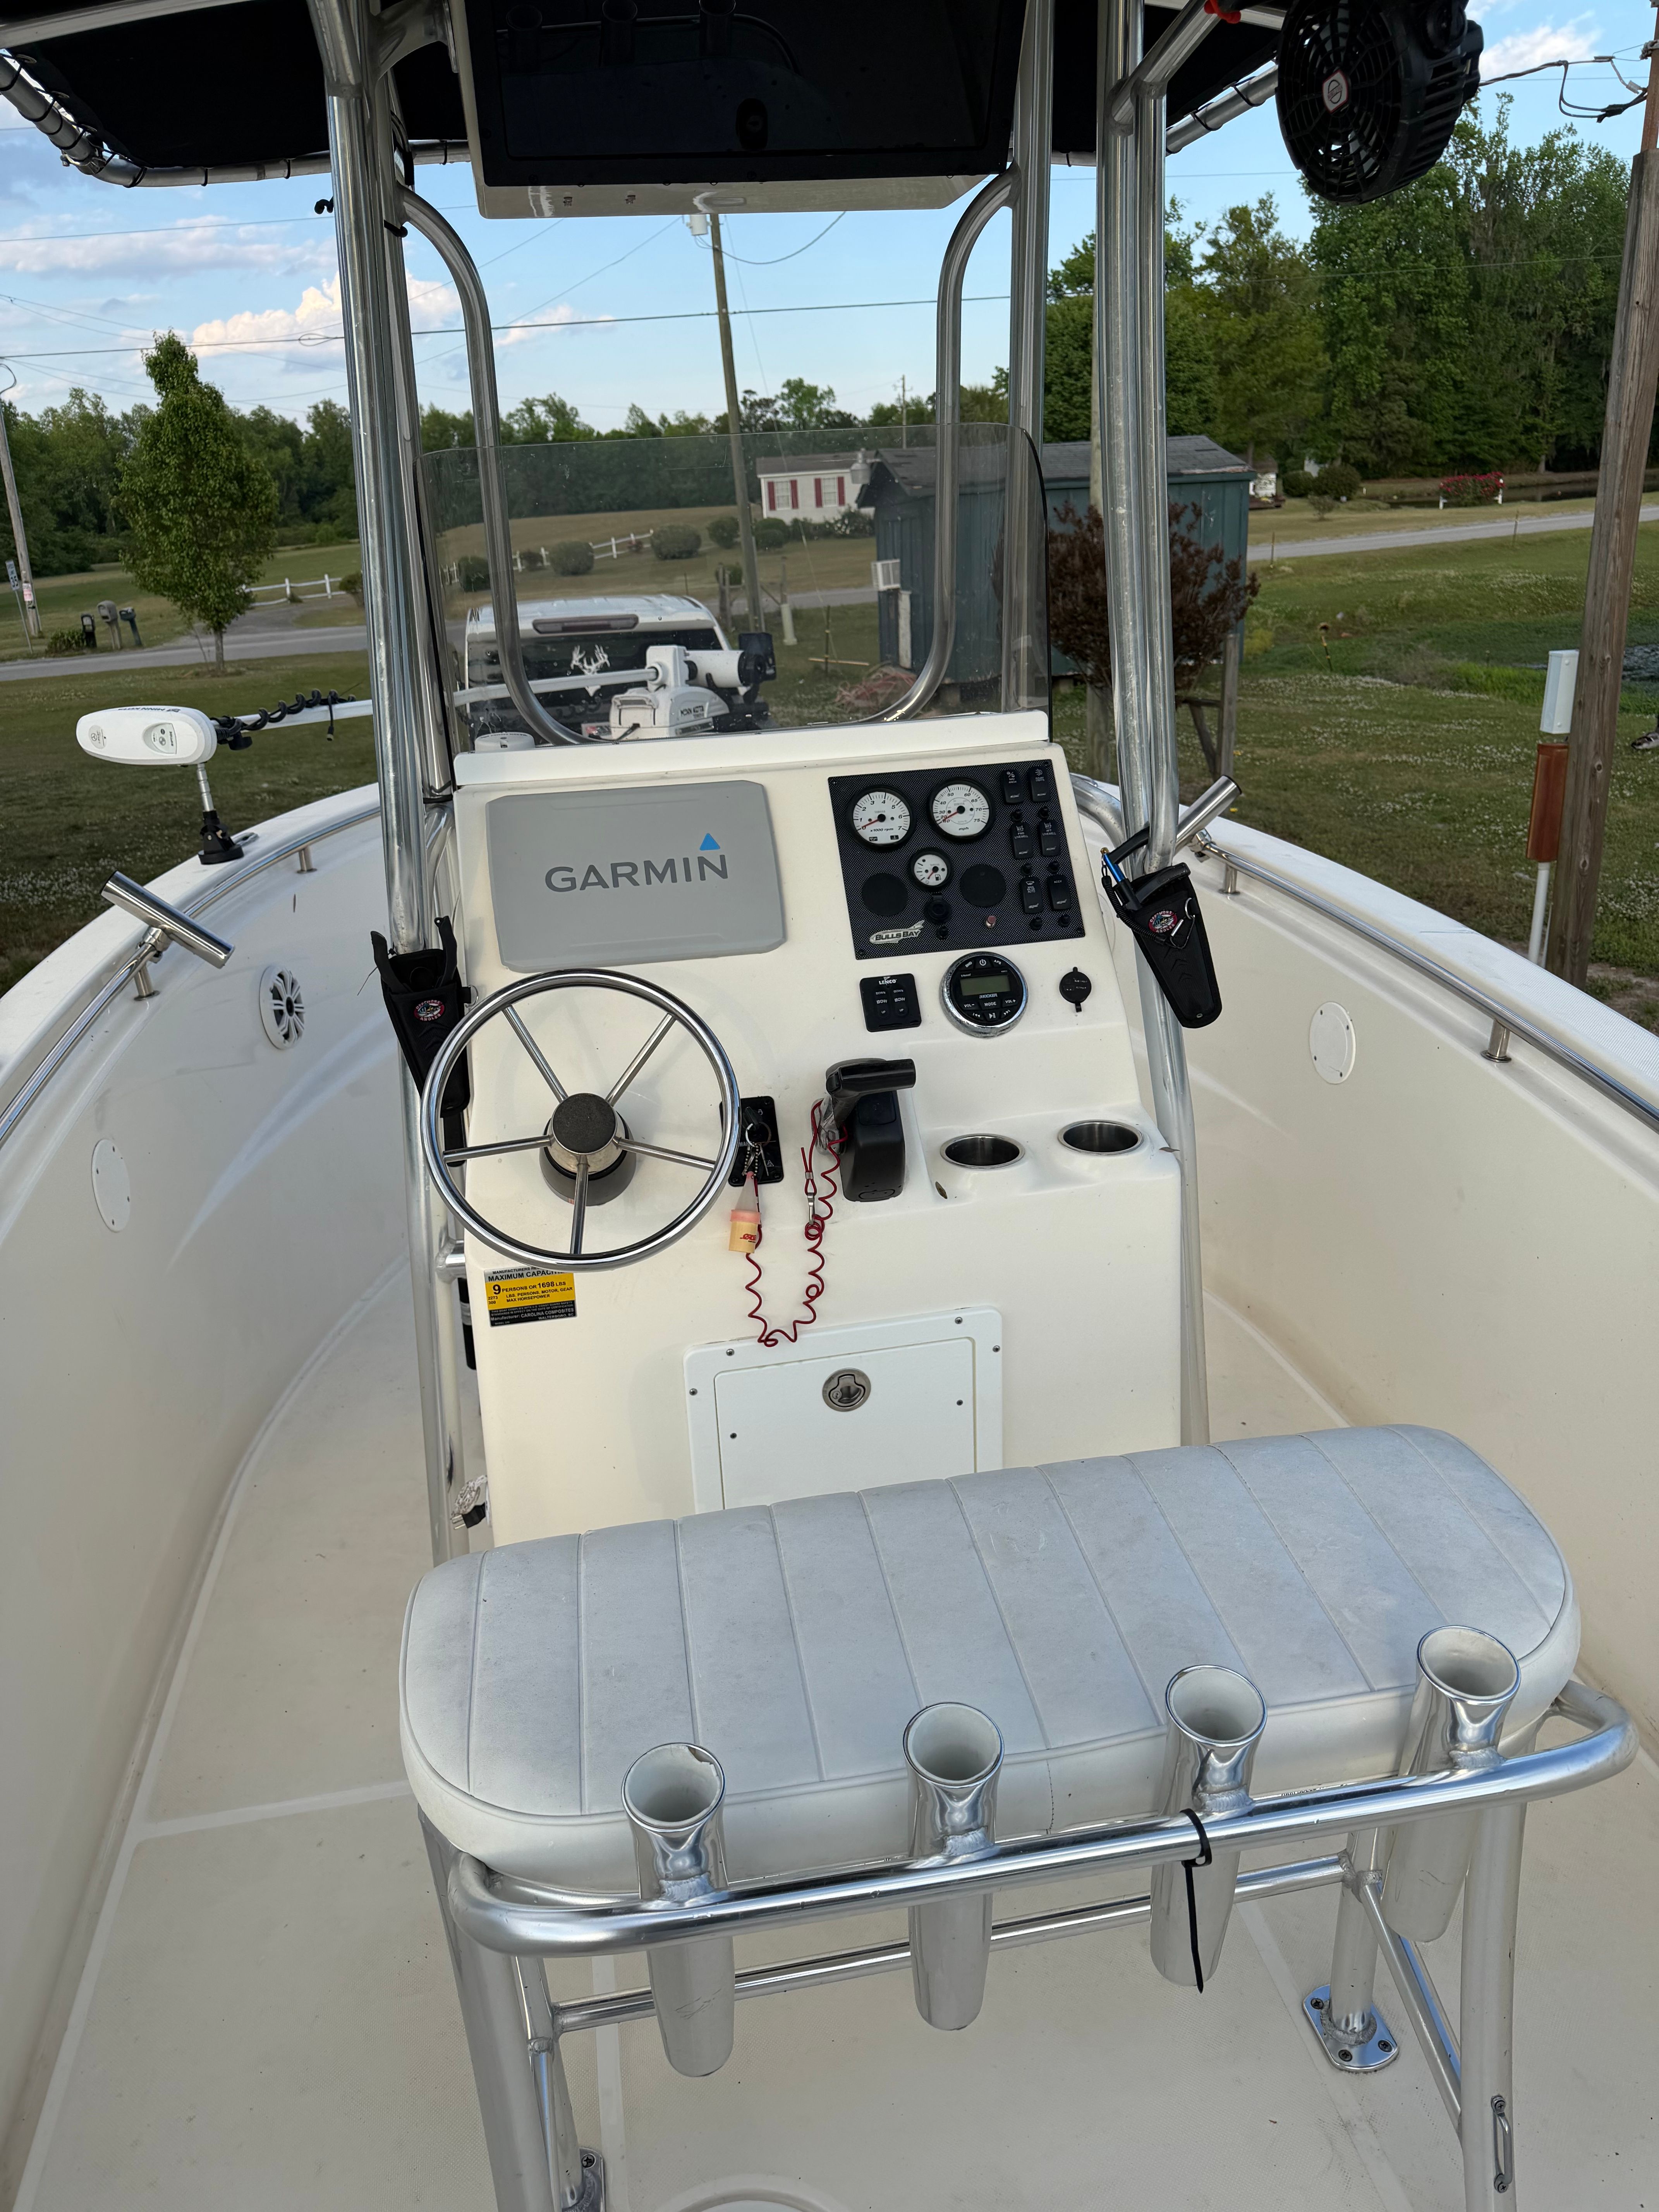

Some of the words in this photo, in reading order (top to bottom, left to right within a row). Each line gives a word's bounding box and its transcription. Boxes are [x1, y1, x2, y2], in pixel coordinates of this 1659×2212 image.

[10, 576, 18, 587] 35
[545, 854, 728, 892] GARMIN
[1156, 924, 1175, 933] ANGLER
[420, 1013, 441, 1021] ANGLER
[488, 1273, 524, 1282] MAXIMUM
[493, 1284, 501, 1295] 9
